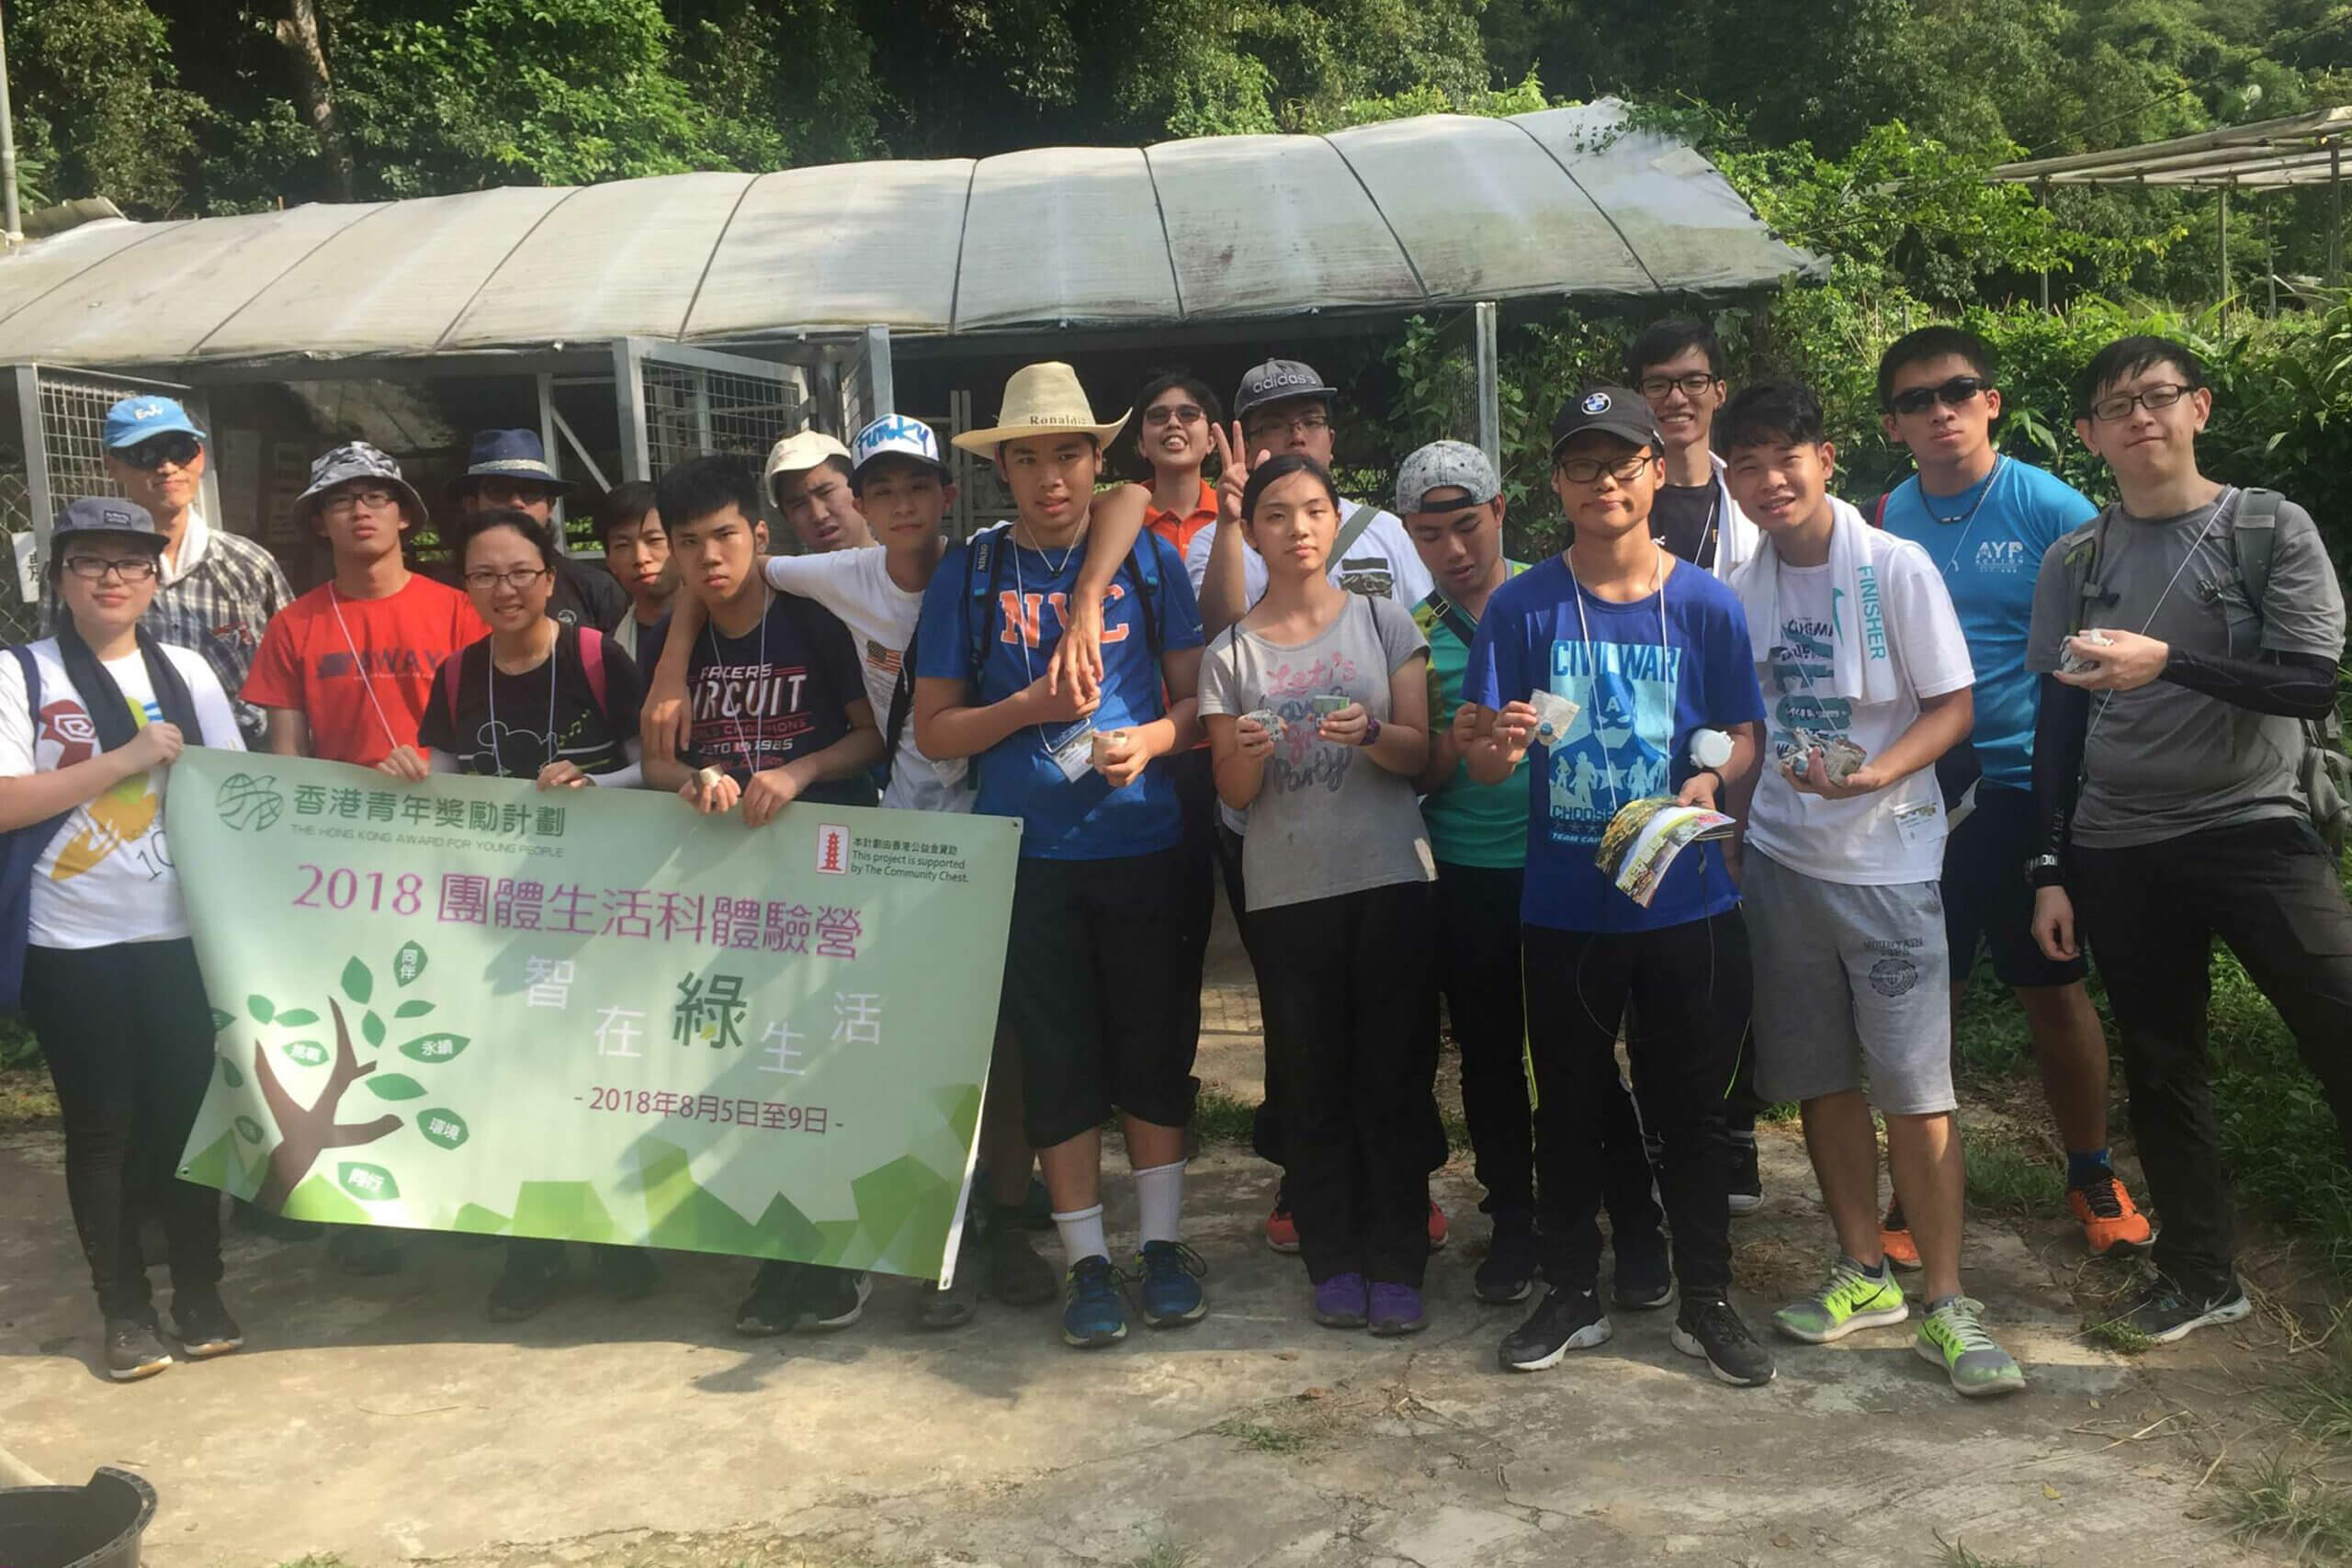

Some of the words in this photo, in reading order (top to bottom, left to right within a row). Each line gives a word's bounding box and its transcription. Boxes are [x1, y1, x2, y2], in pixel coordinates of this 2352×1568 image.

[1252, 373, 1306, 393] adidas
[1857, 565, 1887, 660] FINISHER
[1619, 645, 1678, 683] WAR
[693, 675, 807, 720] IRCUIT
[294, 784, 566, 837] 香港青年獎勵計劃
[290, 824, 316, 836] THE
[319, 827, 354, 839] HONG
[357, 830, 392, 843] KONG
[396, 833, 445, 847] AWARD
[447, 838, 471, 850] FOR
[476, 840, 516, 853] YOUNG
[518, 845, 565, 859] PEOPLE
[851, 863, 864, 874] by
[865, 864, 883, 875] The
[884, 866, 938, 882] Community
[853, 850, 871, 861] This
[873, 852, 907, 864] project
[908, 855, 916, 865] is
[917, 858, 966, 870] supported
